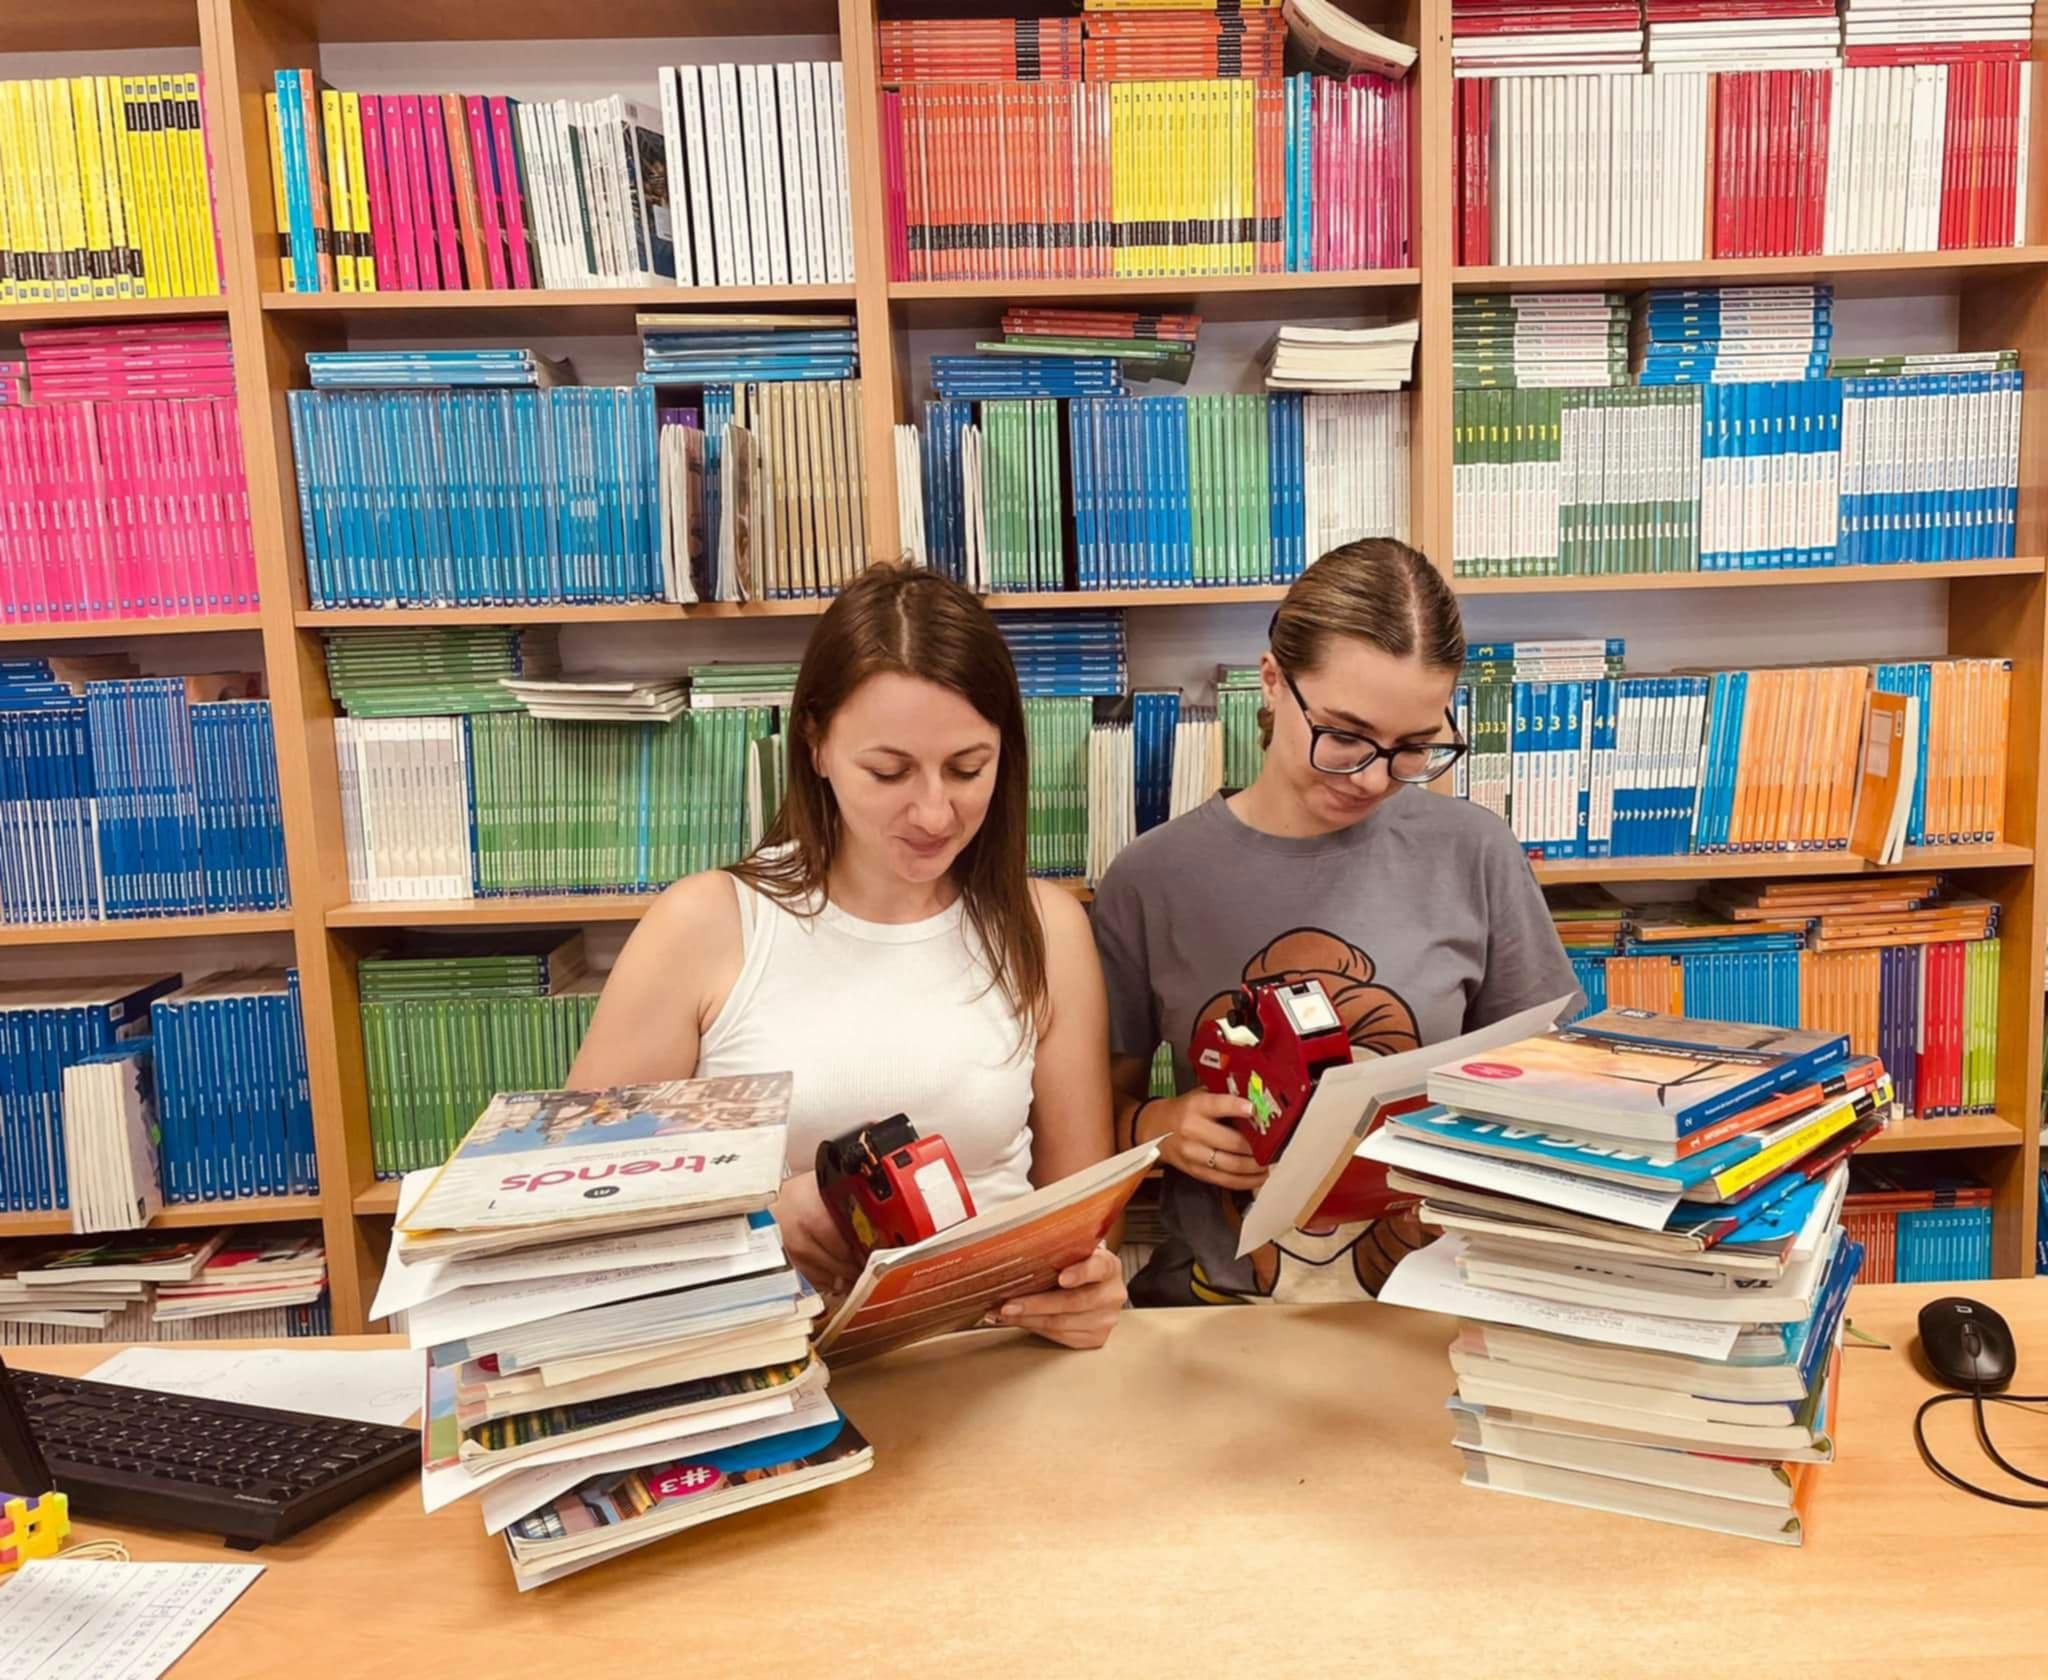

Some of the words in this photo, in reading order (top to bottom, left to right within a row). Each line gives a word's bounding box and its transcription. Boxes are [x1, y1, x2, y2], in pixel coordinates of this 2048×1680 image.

[1706, 421, 1713, 437] 1
[1720, 419, 1727, 435] 1
[1735, 420, 1741, 436] 1
[1750, 419, 1756, 434] 1
[1762, 418, 1769, 433] 1
[1775, 417, 1782, 433] 1
[1790, 416, 1796, 431] 1
[1804, 416, 1811, 432] 1
[1818, 414, 1824, 430] 1
[1831, 414, 1837, 430] 1
[1456, 428, 1461, 443] 1
[1468, 427, 1473, 443] 1
[1480, 425, 1485, 441] 1
[1492, 426, 1497, 441] 1
[1504, 427, 1509, 443] 1
[1516, 425, 1522, 440] 1
[1529, 424, 1535, 440] 1
[1540, 425, 1546, 440] 1
[1552, 424, 1558, 440] 1
[1479, 647, 1493, 656] 3
[1516, 716, 1526, 731] 3
[1534, 716, 1543, 731] 3
[1550, 715, 1561, 730] 3
[1568, 715, 1577, 729] 3
[1594, 716, 1603, 729] 4
[1608, 715, 1615, 728] 4
[499, 1153, 740, 1193] #trends
[660, 1467, 711, 1492] #3
